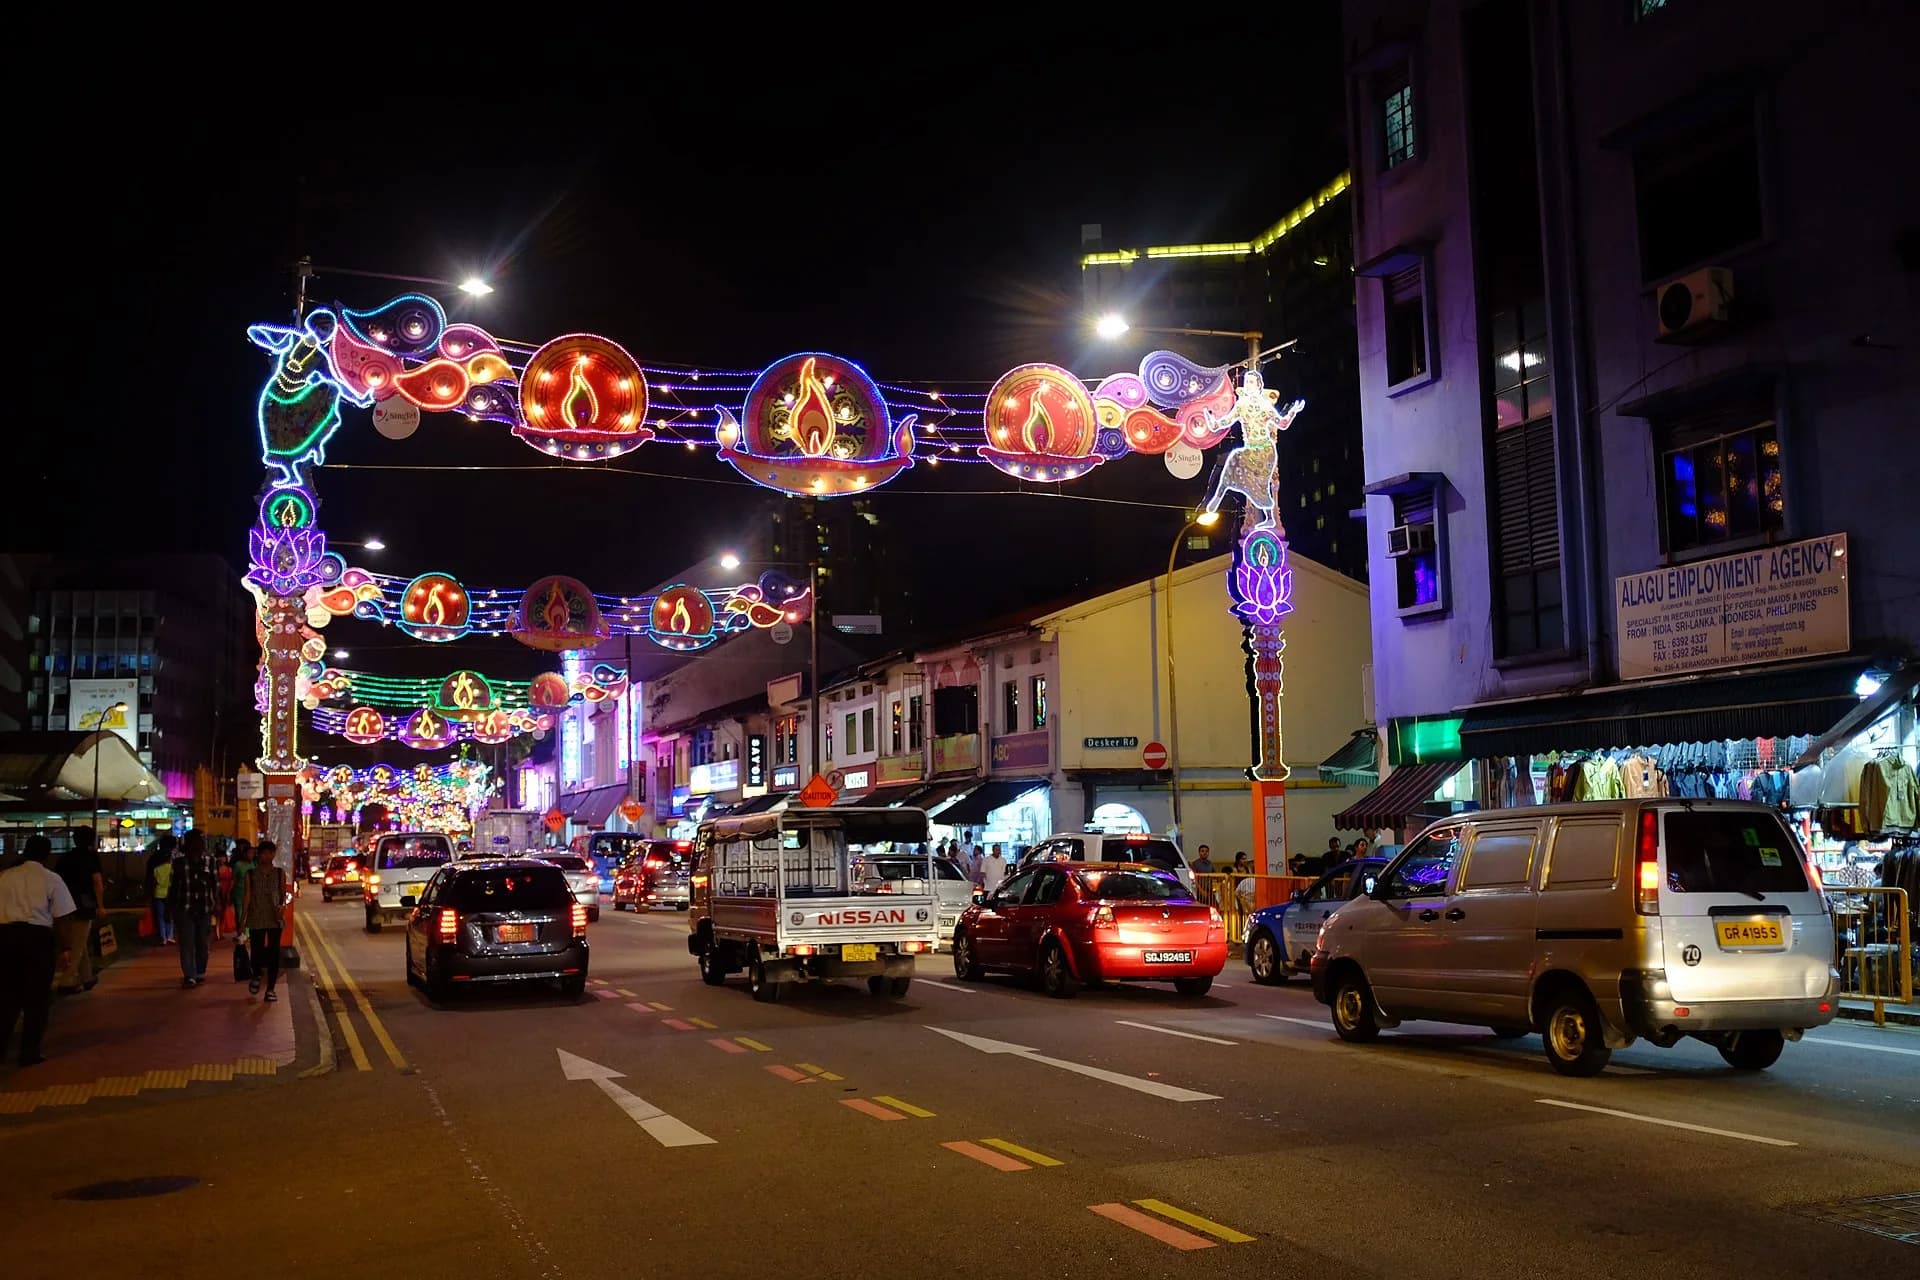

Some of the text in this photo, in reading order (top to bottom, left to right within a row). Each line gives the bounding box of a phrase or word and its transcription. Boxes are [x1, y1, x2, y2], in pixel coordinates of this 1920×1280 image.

[1621, 541, 1834, 608] ALAGU EMPLOYMENT AGENCY
[1626, 615, 1662, 629] SPECIALIST
[1663, 614, 1670, 623] IN
[1672, 604, 1722, 621] RECRUITEMENT
[1725, 602, 1735, 613] OF
[1735, 597, 1767, 610] FOREIGN
[1768, 593, 1791, 604] MAIDS
[1800, 585, 1839, 600] WORKERS
[1766, 600, 1817, 617] PHILLIPINES
[1672, 635, 1689, 647] 6392
[1690, 633, 1708, 645] 4337
[1672, 648, 1689, 660] 6392
[1691, 645, 1708, 656] 2644
[1087, 737, 1135, 747] Desker Rd
[993, 743, 1010, 762] ABC
[803, 791, 832, 801] CAUTION
[818, 909, 906, 926] NISSAN
[1724, 926, 1778, 939] GR 4195 S
[1685, 947, 1700, 960] 70
